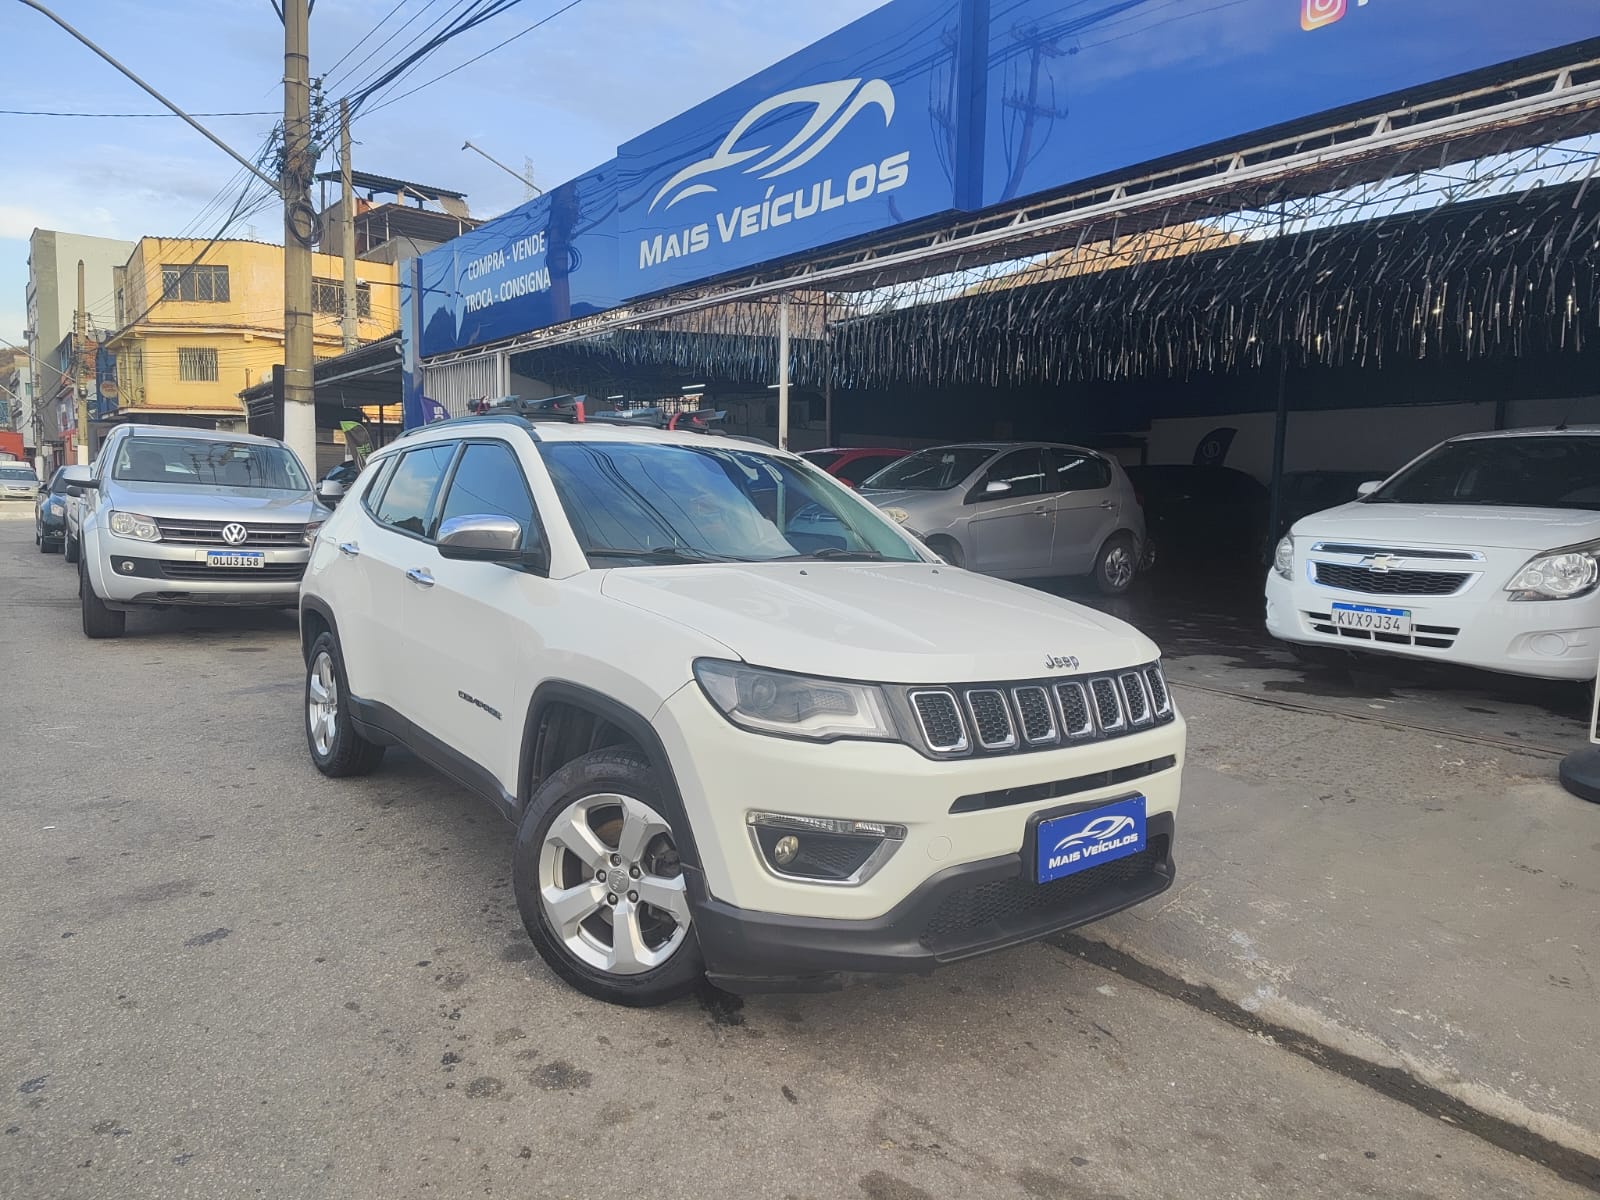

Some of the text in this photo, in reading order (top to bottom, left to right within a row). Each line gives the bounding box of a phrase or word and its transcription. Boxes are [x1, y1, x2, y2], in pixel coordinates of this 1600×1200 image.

[639, 150, 910, 270] MAIS VEÍCULOS
[467, 249, 505, 280] COMPRA
[512, 230, 545, 262] VENDE
[465, 288, 494, 313] TROCA
[500, 266, 552, 302] CONSIGNA
[1337, 610, 1401, 632] KVX9J34
[1045, 653, 1080, 671] Jeep
[1048, 832, 1139, 870] MAIS VEÍCULOS
